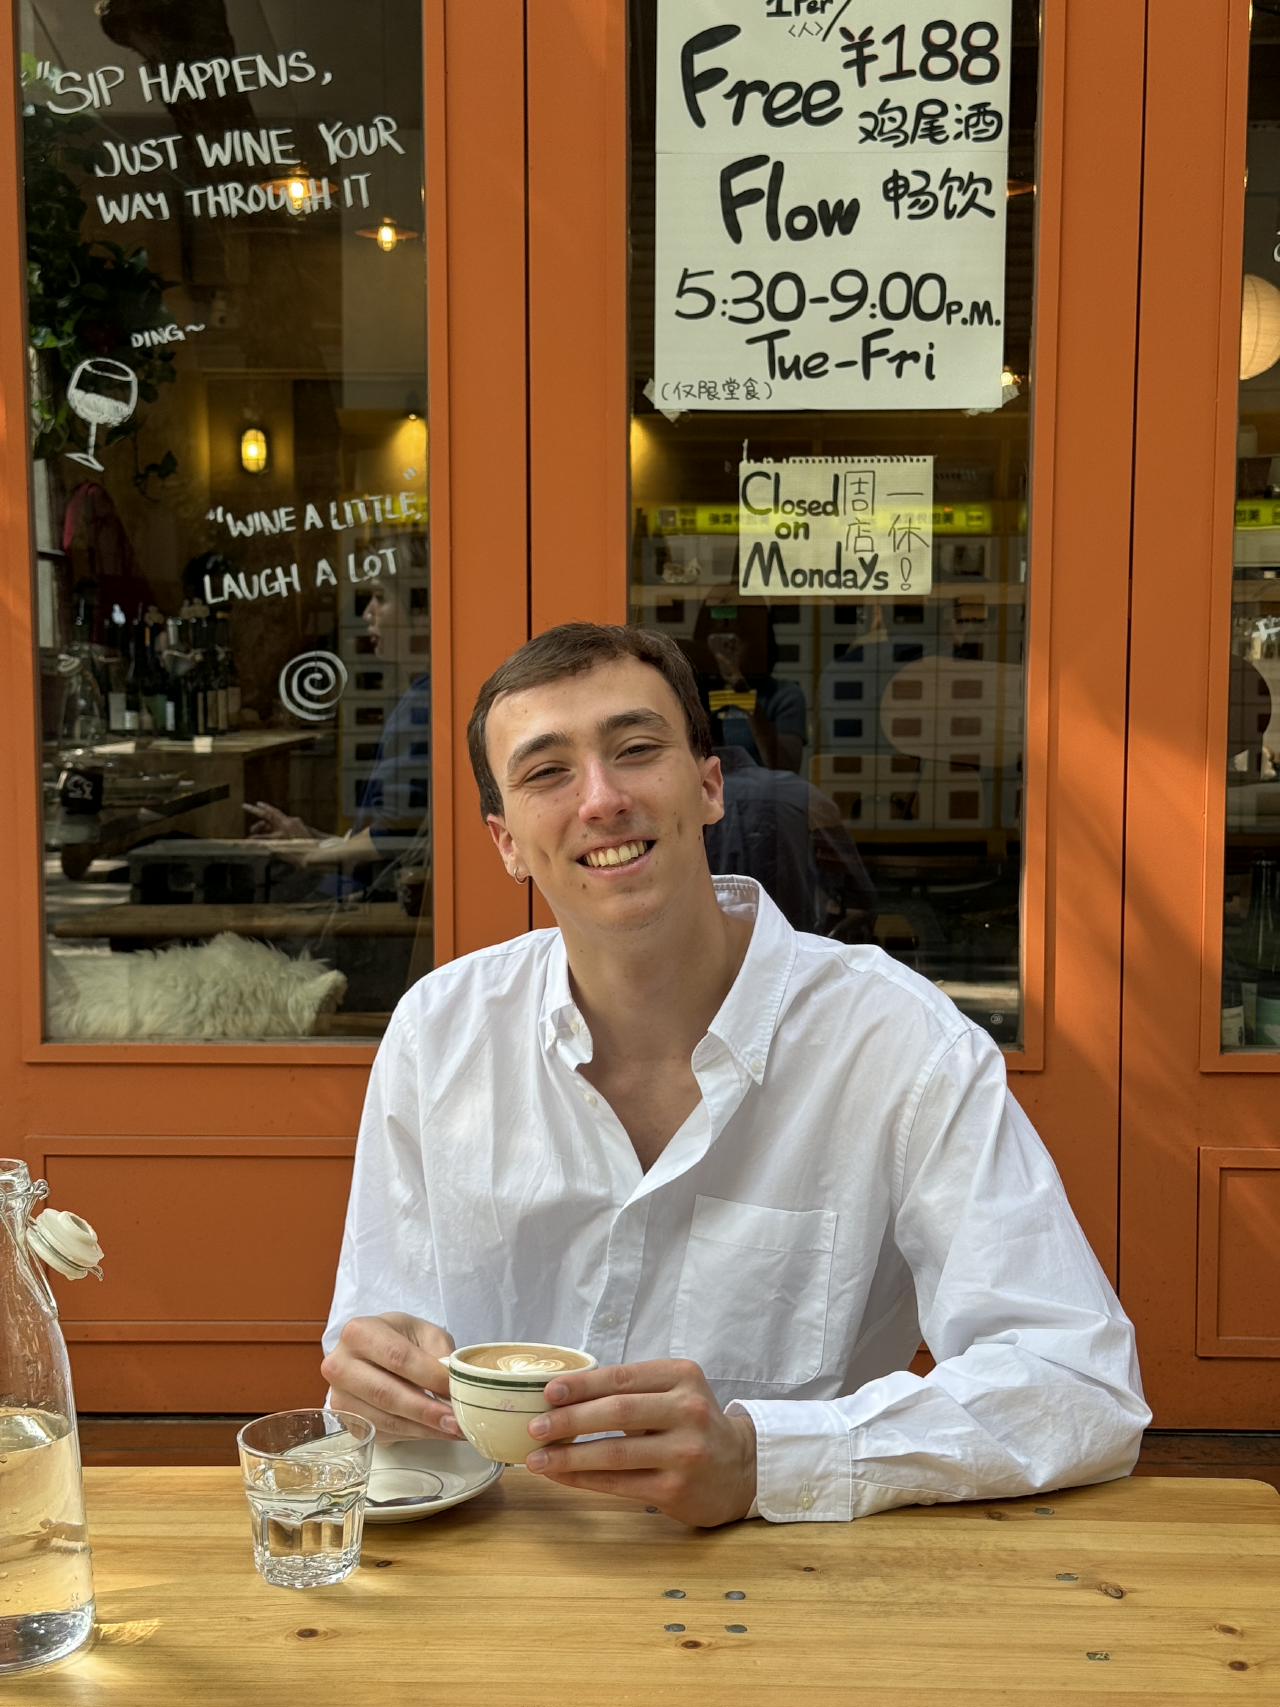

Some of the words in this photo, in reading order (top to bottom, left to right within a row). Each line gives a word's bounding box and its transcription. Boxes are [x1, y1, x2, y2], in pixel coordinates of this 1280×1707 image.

[139, 51, 334, 104] HAPPENS,
[681, 24, 843, 128] Free
[839, 19, 1000, 87] ¥188
[94, 135, 183, 178] JUST
[197, 128, 300, 169] WINE
[318, 116, 406, 165] YOUR
[858, 98, 1003, 148] 鸡尾酒
[97, 190, 170, 225] WAY
[343, 172, 371, 208] IT
[720, 154, 860, 244] Flow
[882, 167, 996, 220] 畅饮
[304, 503, 324, 531] A
[741, 471, 839, 518] Closed
[774, 520, 811, 540] on
[203, 563, 301, 604] LAUGH
[315, 558, 338, 587] A
[347, 547, 397, 583] LOT
[742, 541, 889, 592] Mondays
